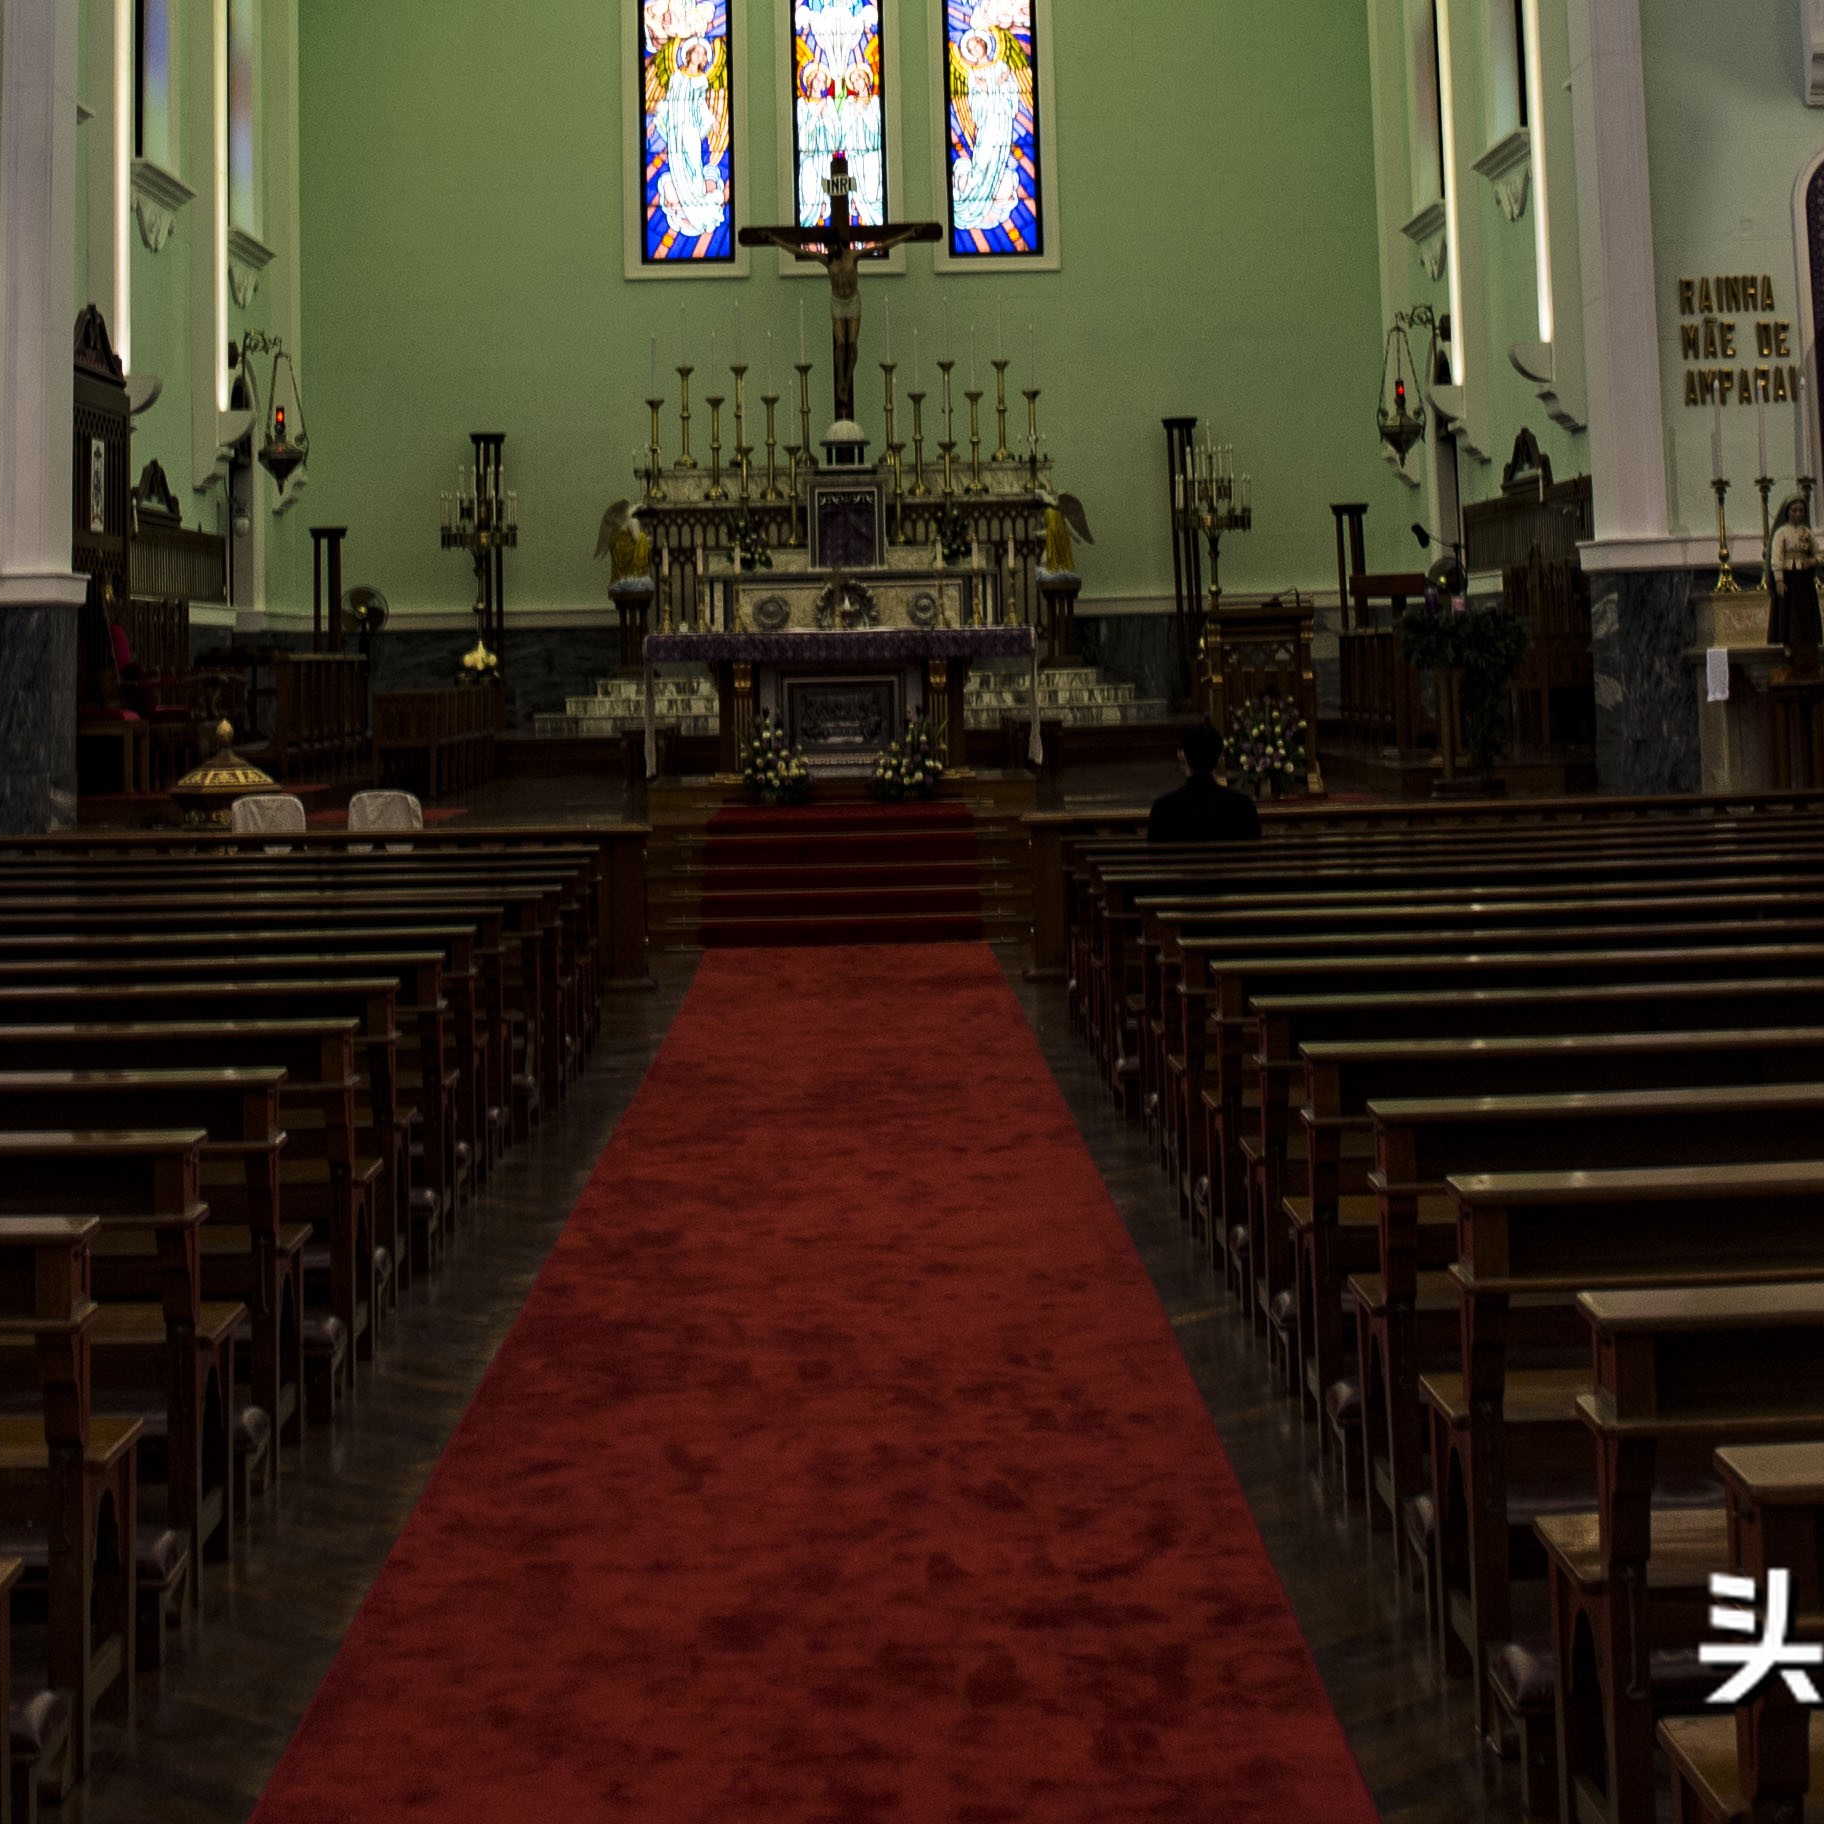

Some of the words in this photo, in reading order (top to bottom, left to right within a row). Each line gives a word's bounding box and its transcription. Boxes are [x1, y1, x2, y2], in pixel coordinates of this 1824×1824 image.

[826, 176, 852, 194] INRI
[1679, 274, 1775, 315] RAINHA
[1680, 316, 1736, 360] MÃE
[1756, 320, 1790, 358] DE
[1684, 364, 1797, 407] AMPARAI
